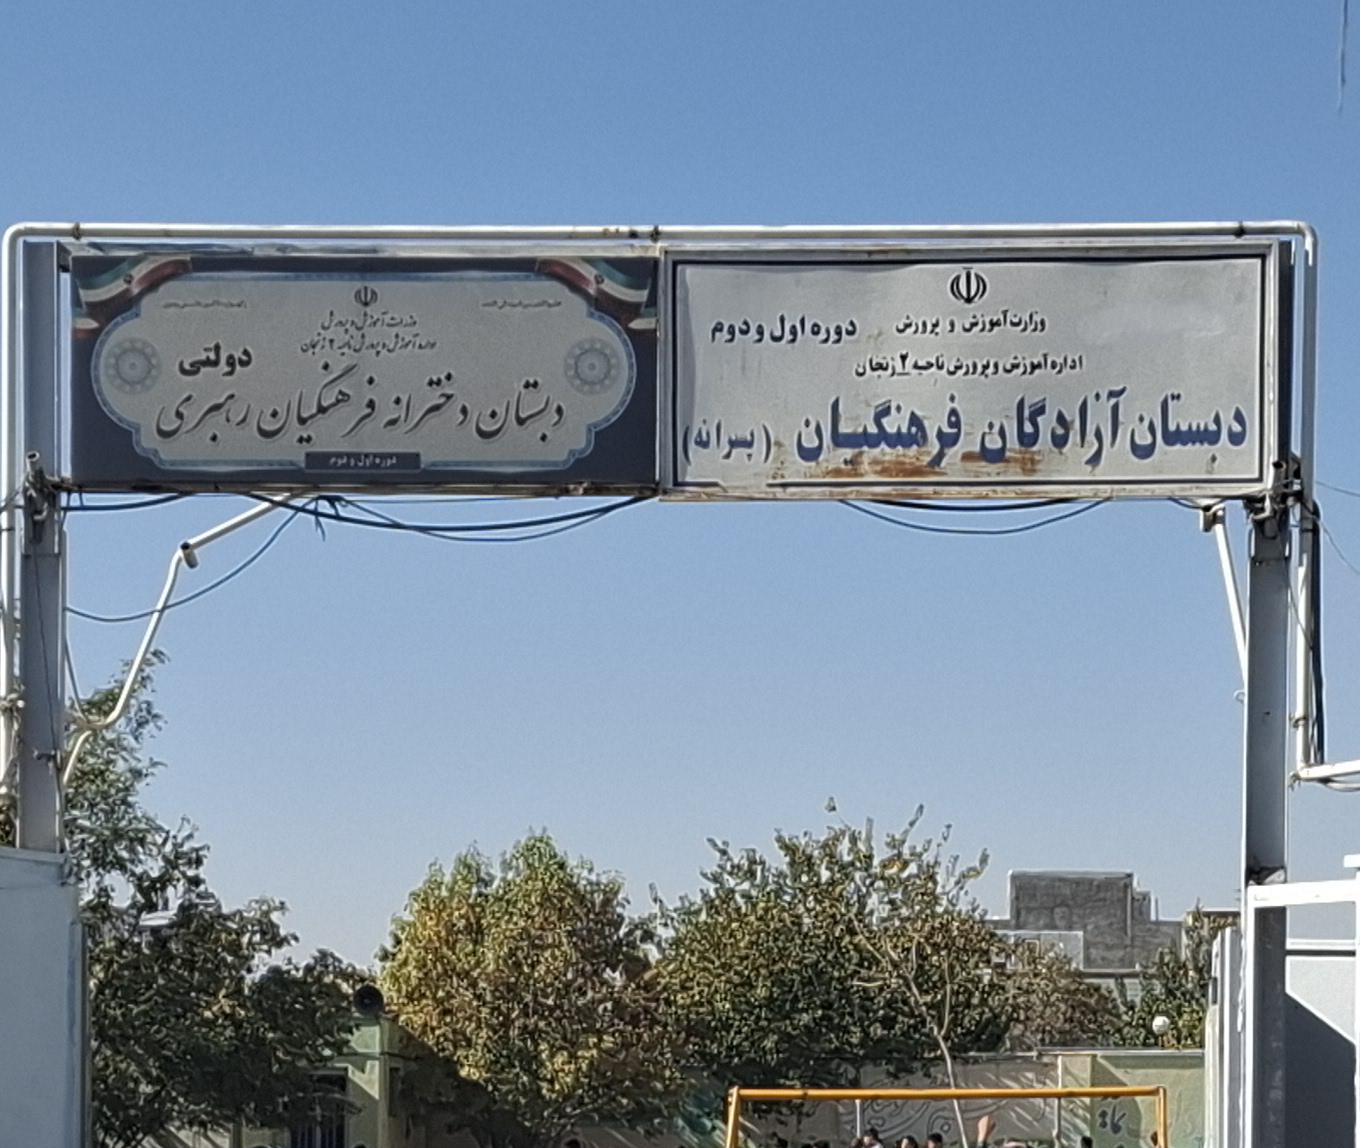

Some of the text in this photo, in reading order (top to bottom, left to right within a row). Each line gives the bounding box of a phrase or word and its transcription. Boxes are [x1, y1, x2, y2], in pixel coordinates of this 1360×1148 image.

[710, 312, 858, 345] دوره اول و دوم
[895, 308, 1047, 336] وزارت آموزش و پرورش
[177, 340, 253, 377] دولتی
[854, 352, 897, 378] زنجان
[912, 353, 945, 376] ناحیه
[1001, 352, 1049, 376] آموزش
[1050, 354, 1084, 375] اداره
[155, 360, 564, 445] دبستان دخترانه فرهنگیان رهبری
[795, 392, 964, 468] فرهنگیان
[978, 385, 1128, 467] آزادگان
[1128, 391, 1248, 465] دبستان
